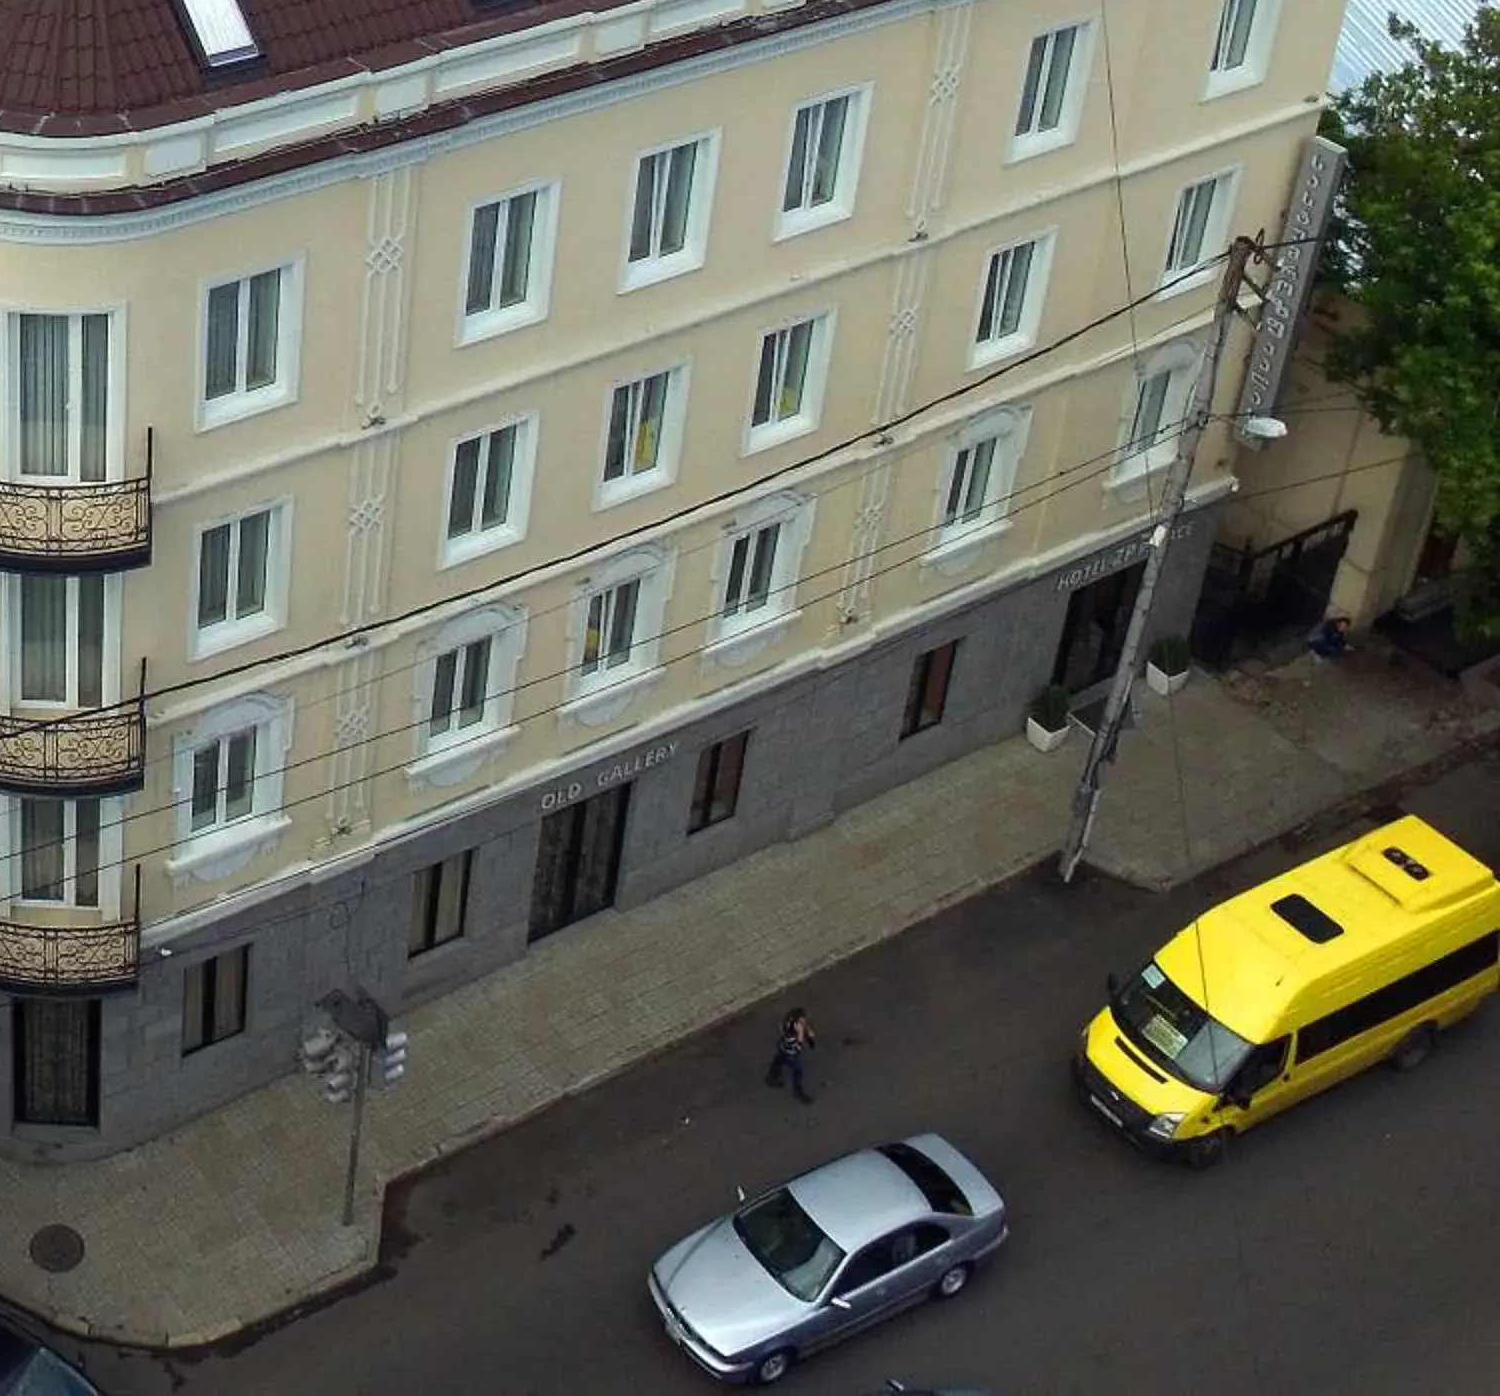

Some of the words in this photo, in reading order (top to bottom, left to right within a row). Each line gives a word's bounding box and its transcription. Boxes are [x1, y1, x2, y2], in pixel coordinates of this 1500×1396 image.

[1057, 557, 1107, 591] HOTEL
[540, 782, 582, 810] OLD
[596, 740, 679, 787] GALLERY
